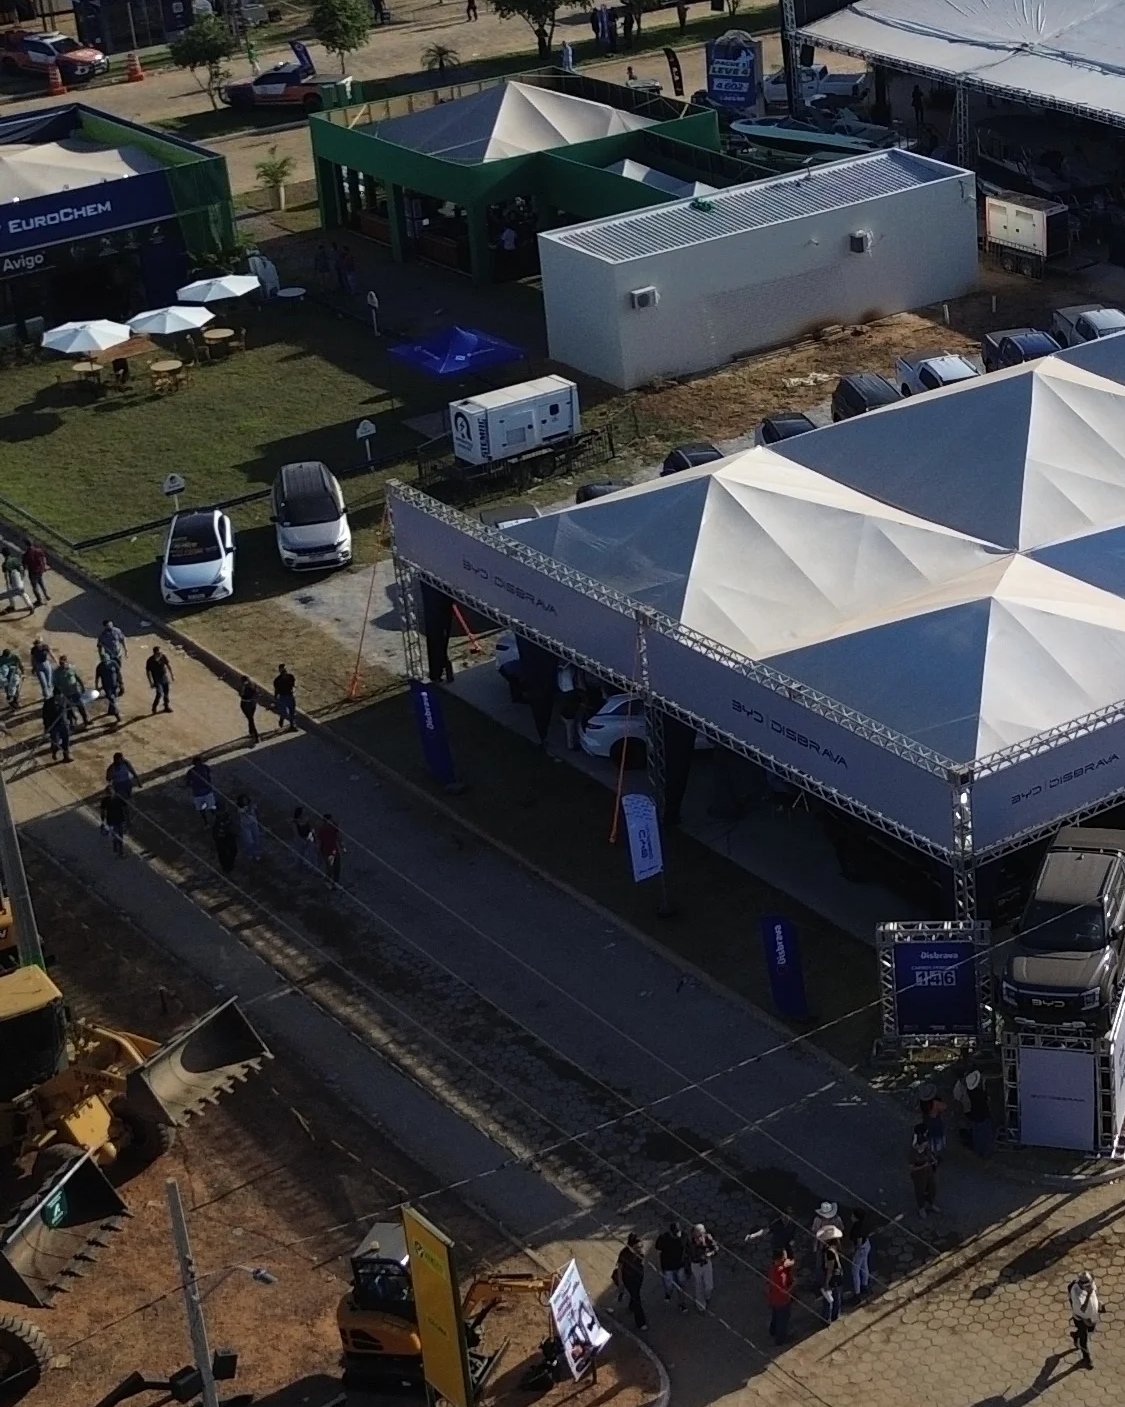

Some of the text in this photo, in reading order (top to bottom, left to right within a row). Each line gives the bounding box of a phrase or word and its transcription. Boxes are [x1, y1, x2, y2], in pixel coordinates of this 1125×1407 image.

[711, 66, 740, 75] LEVE
[3, 253, 45, 272] Avigo
[732, 699, 848, 769] BYD DISBRAVA
[1011, 753, 1120, 805] BYD DISBRAVA
[1031, 998, 1066, 1008] BYD
